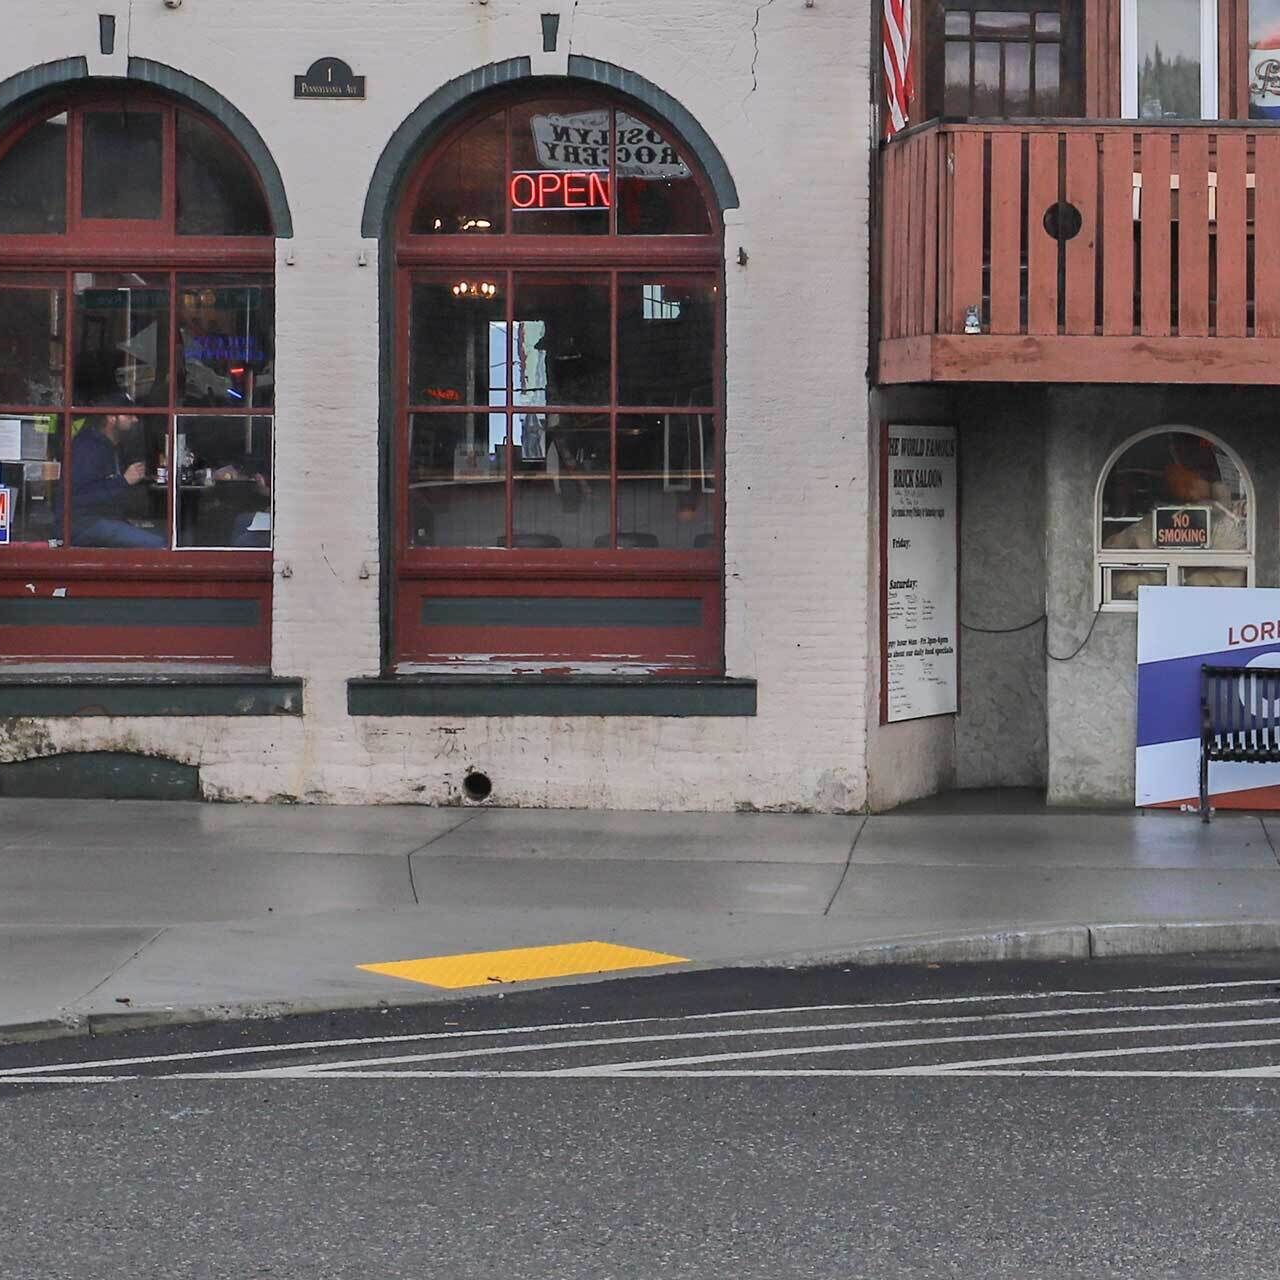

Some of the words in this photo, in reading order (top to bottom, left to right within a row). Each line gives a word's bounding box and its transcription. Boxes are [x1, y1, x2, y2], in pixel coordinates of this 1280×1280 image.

[510, 172, 611, 208] OPEN
[893, 469, 914, 488] BRICK
[915, 469, 942, 488] SALOON
[1173, 513, 1190, 527] NO
[1158, 529, 1206, 542] SMOKING
